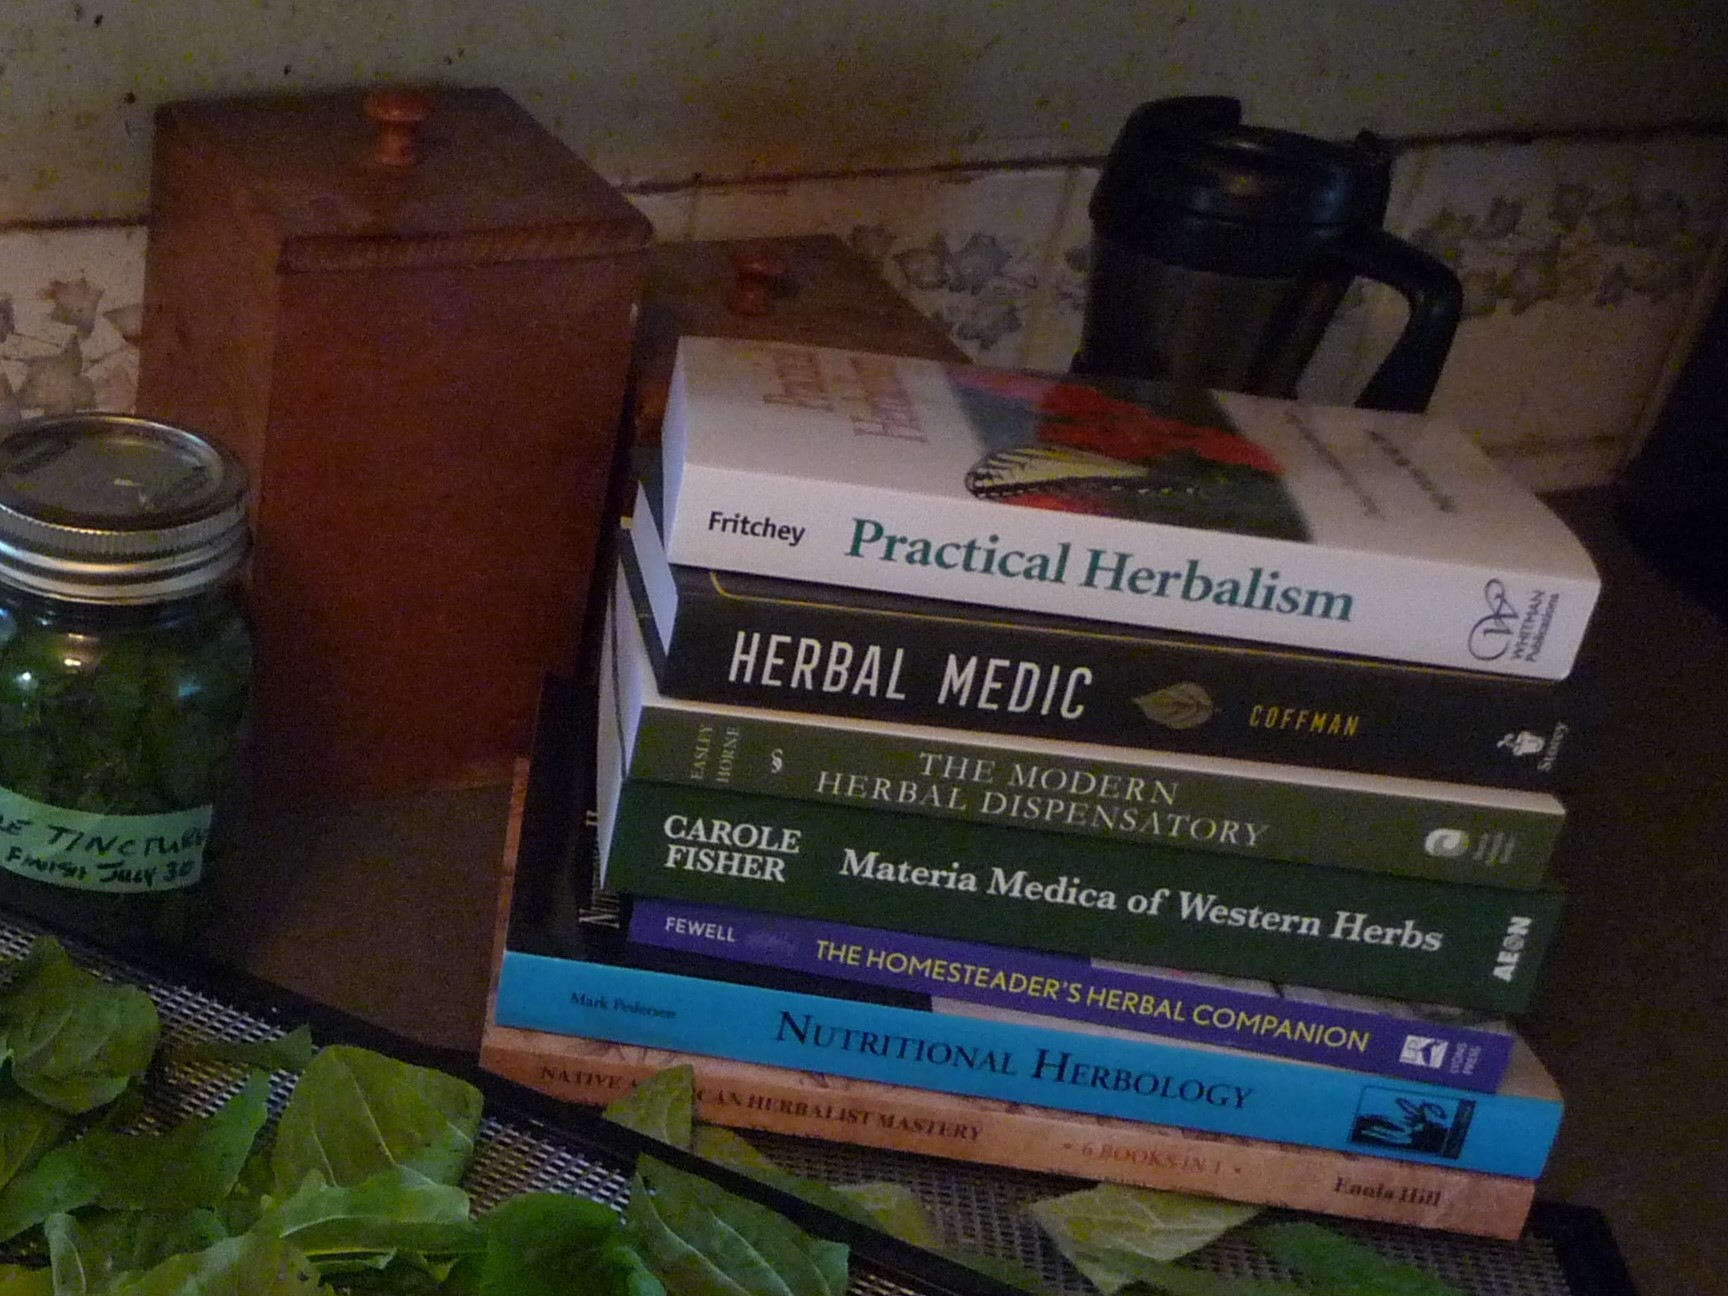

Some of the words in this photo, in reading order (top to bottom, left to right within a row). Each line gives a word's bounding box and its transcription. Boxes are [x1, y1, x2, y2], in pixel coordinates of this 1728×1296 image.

[708, 511, 806, 547] Fritchey
[845, 518, 1072, 584] Practical
[1078, 548, 1355, 622] Herbalism
[1509, 589, 1547, 660] WHITMAN
[728, 631, 906, 700] HERBAL
[937, 653, 1093, 721] MEDIC
[1249, 703, 1359, 737] COFFMAN
[815, 771, 968, 811] HERBAL
[979, 791, 1270, 848] DISPENSATORY
[919, 751, 994, 784] THE
[1010, 762, 1177, 807] MODERN
[665, 814, 802, 854] CAROLE
[665, 844, 786, 883] FISHER
[665, 917, 737, 943] FEWELL
[839, 849, 977, 892] Materia
[986, 867, 1117, 910] Medica
[1127, 888, 1169, 916] of
[1178, 891, 1321, 937] Western
[1329, 911, 1443, 952] Herbs
[1492, 916, 1532, 983] AEON
[571, 991, 608, 1009] Mark
[816, 940, 862, 967] THE
[866, 949, 1082, 1002] HOMESTEADER'S
[1087, 988, 1185, 1022] HERBAL
[1193, 1004, 1370, 1053] COMPANION
[541, 1066, 623, 1091] NATIVE
[747, 1093, 873, 1126] HERBALIST
[878, 1114, 983, 1141] MASTERY
